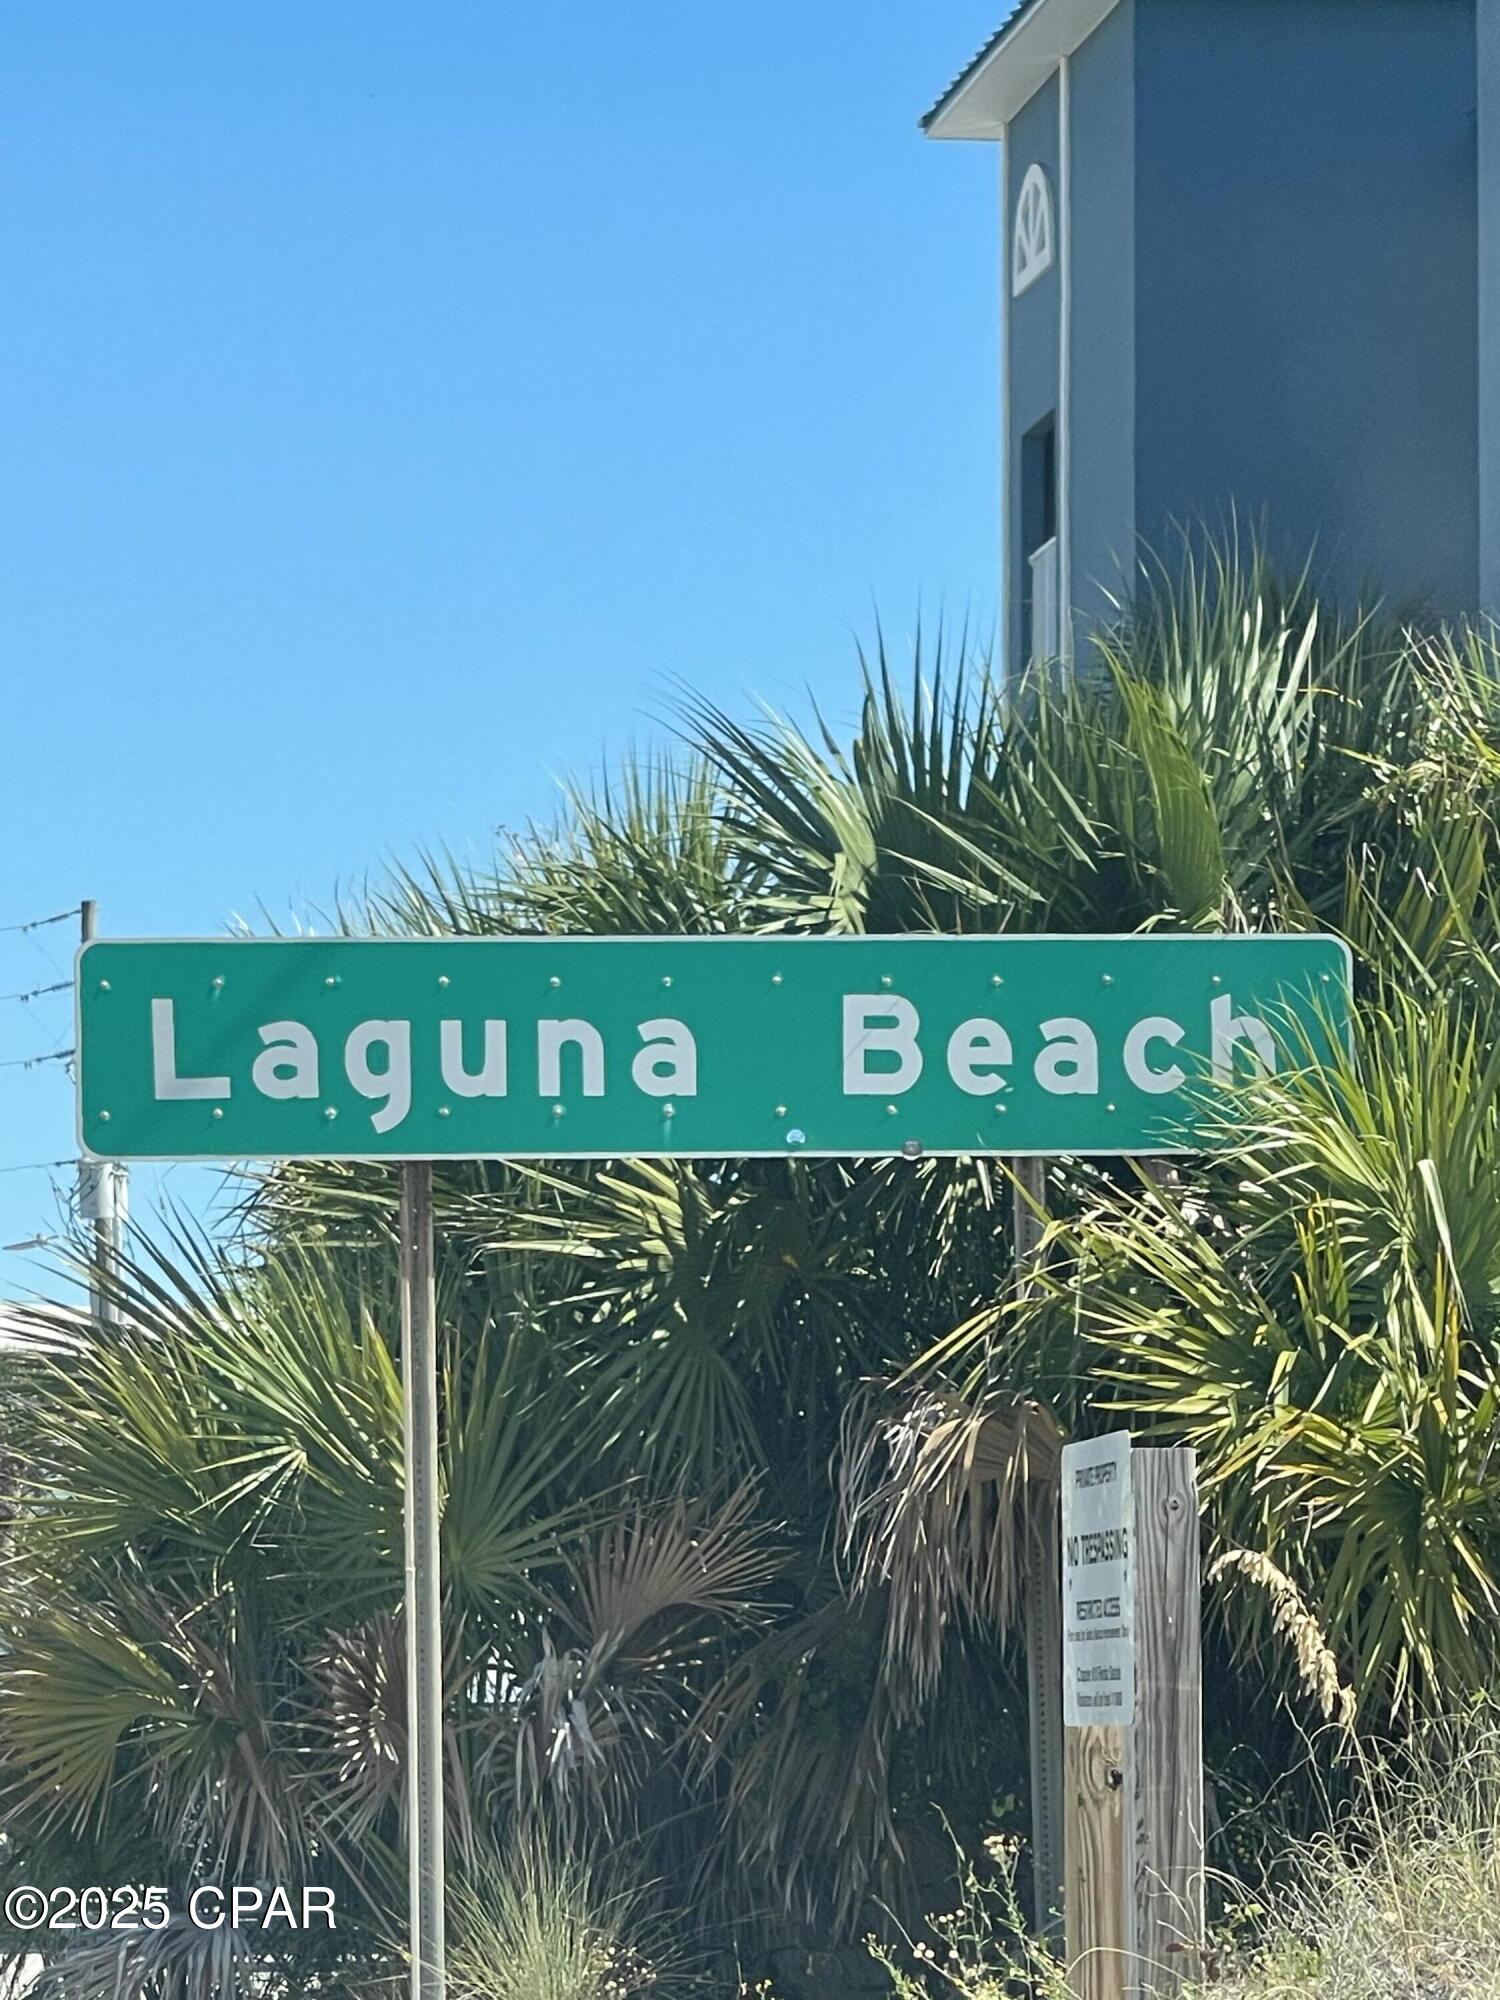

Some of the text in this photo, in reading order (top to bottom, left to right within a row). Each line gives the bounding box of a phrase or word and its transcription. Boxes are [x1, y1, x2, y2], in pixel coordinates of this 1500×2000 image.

[152, 993, 1277, 1134] Laguna Beach
[1067, 1535, 1080, 1566] NO
